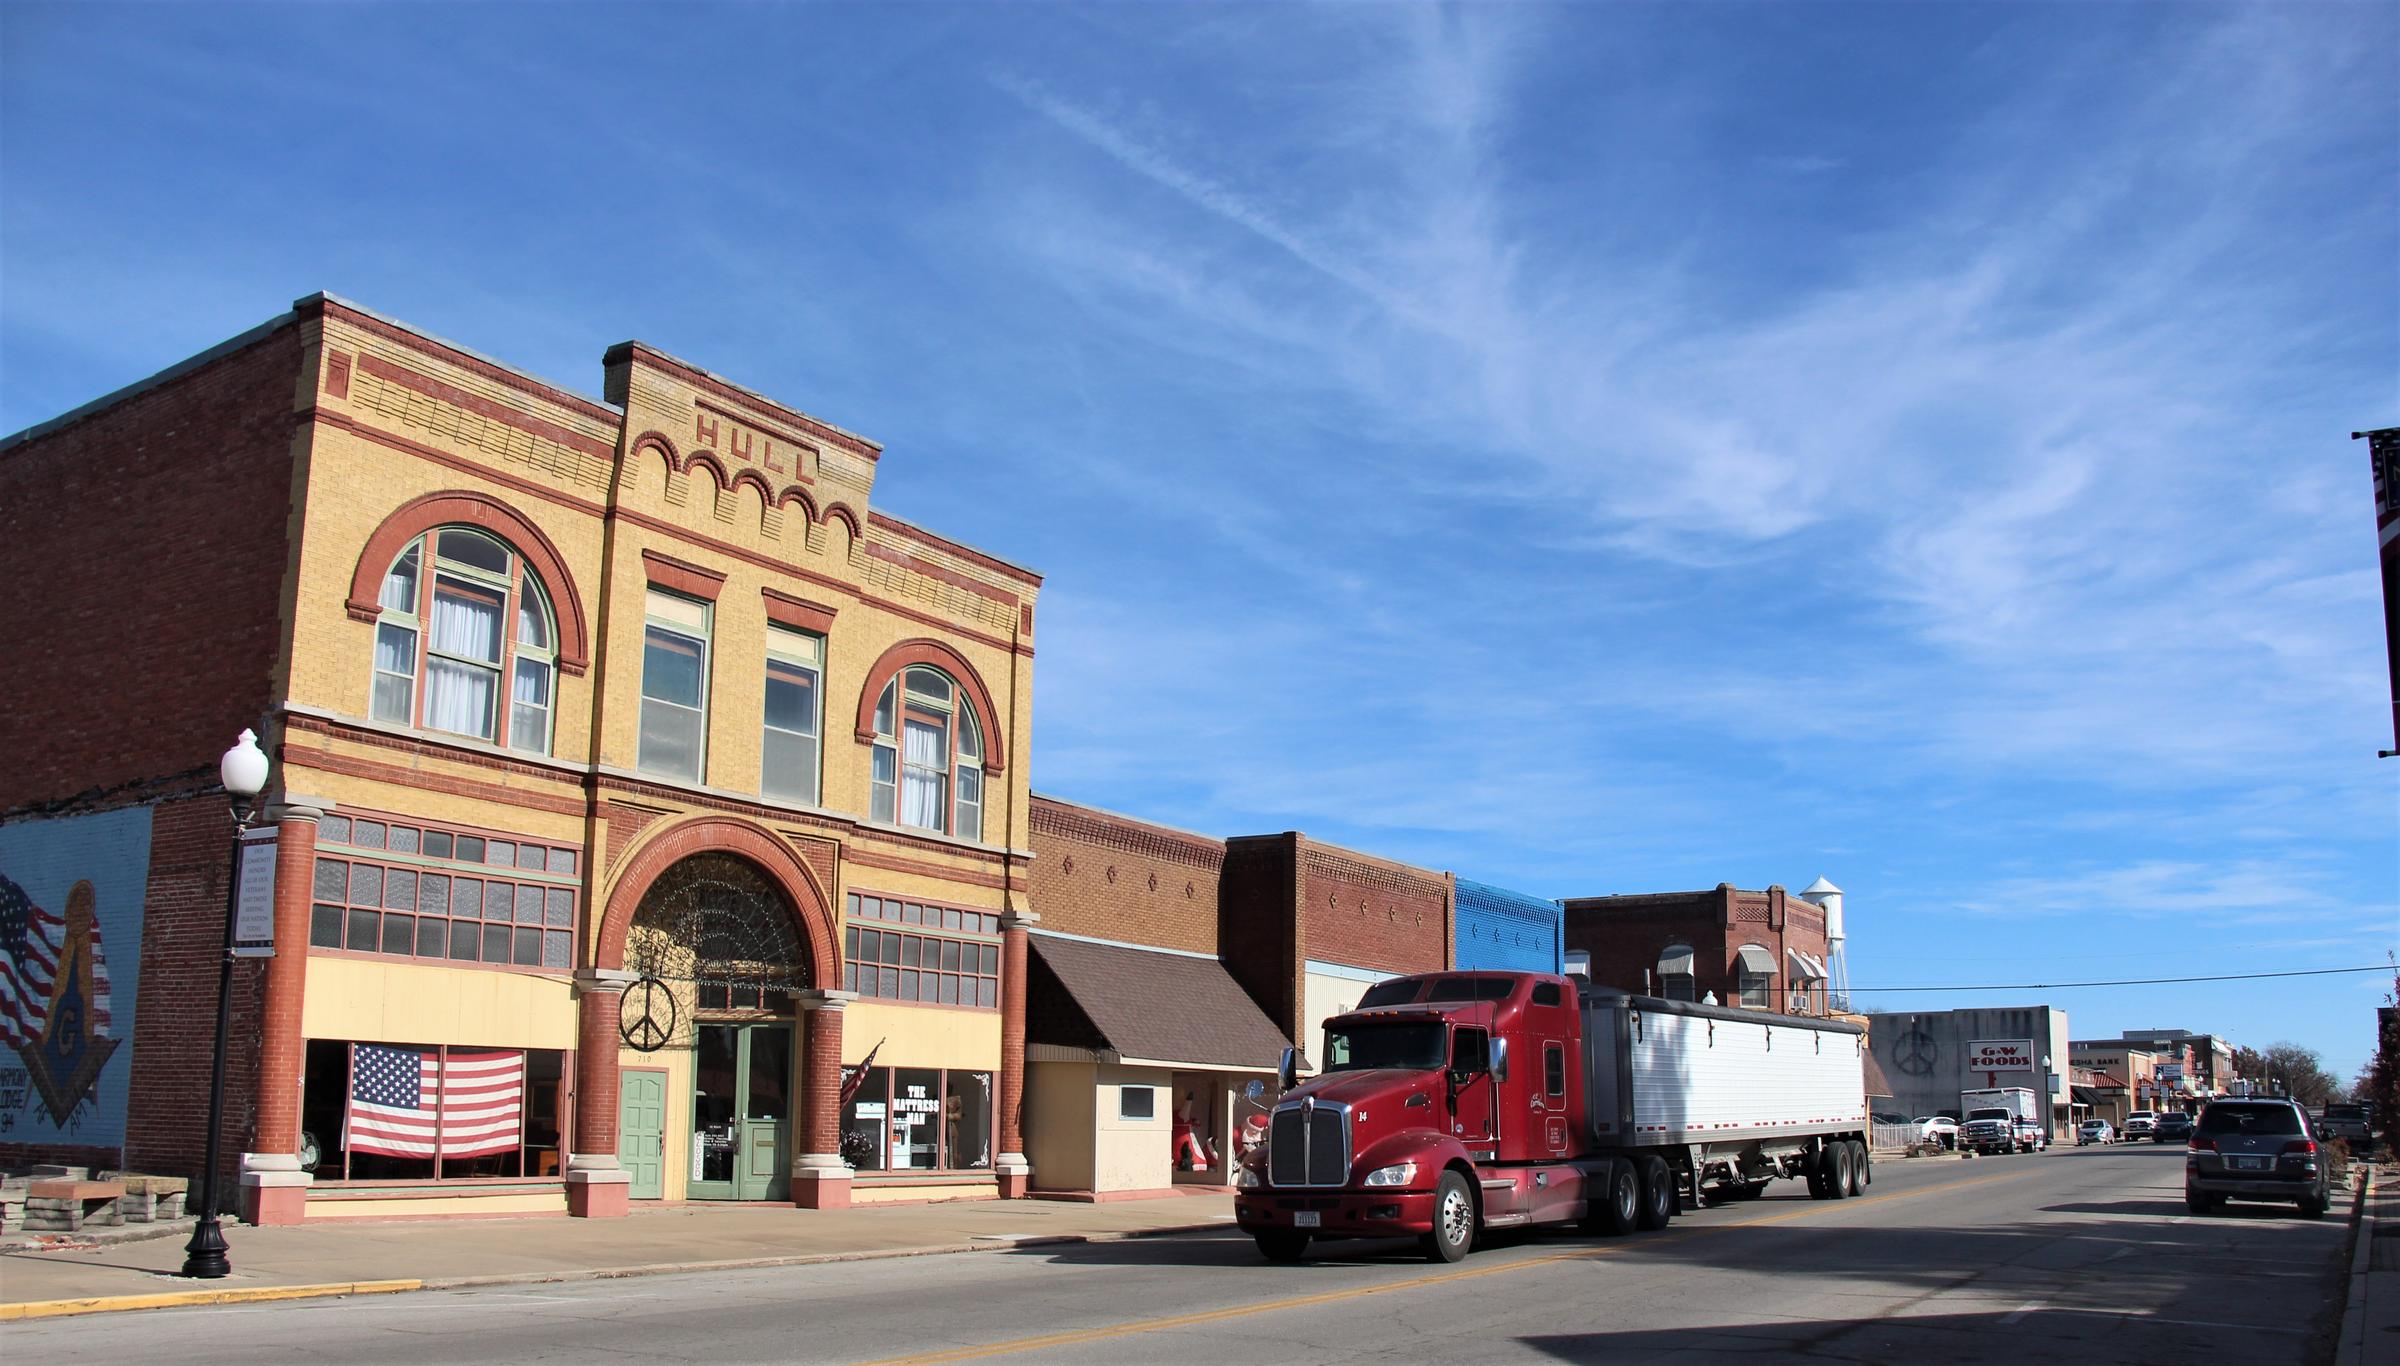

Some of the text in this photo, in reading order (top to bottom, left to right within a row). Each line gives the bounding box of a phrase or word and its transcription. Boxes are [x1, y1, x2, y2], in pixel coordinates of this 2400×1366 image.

[697, 414, 815, 486] HULL
[638, 1055, 652, 1063] 710
[1971, 1056, 2030, 1066] FOODS
[907, 1085, 925, 1098] THE
[893, 1098, 939, 1112] MATTRESS
[907, 1113, 925, 1125] MAN
[1358, 1111, 1368, 1122] 14
